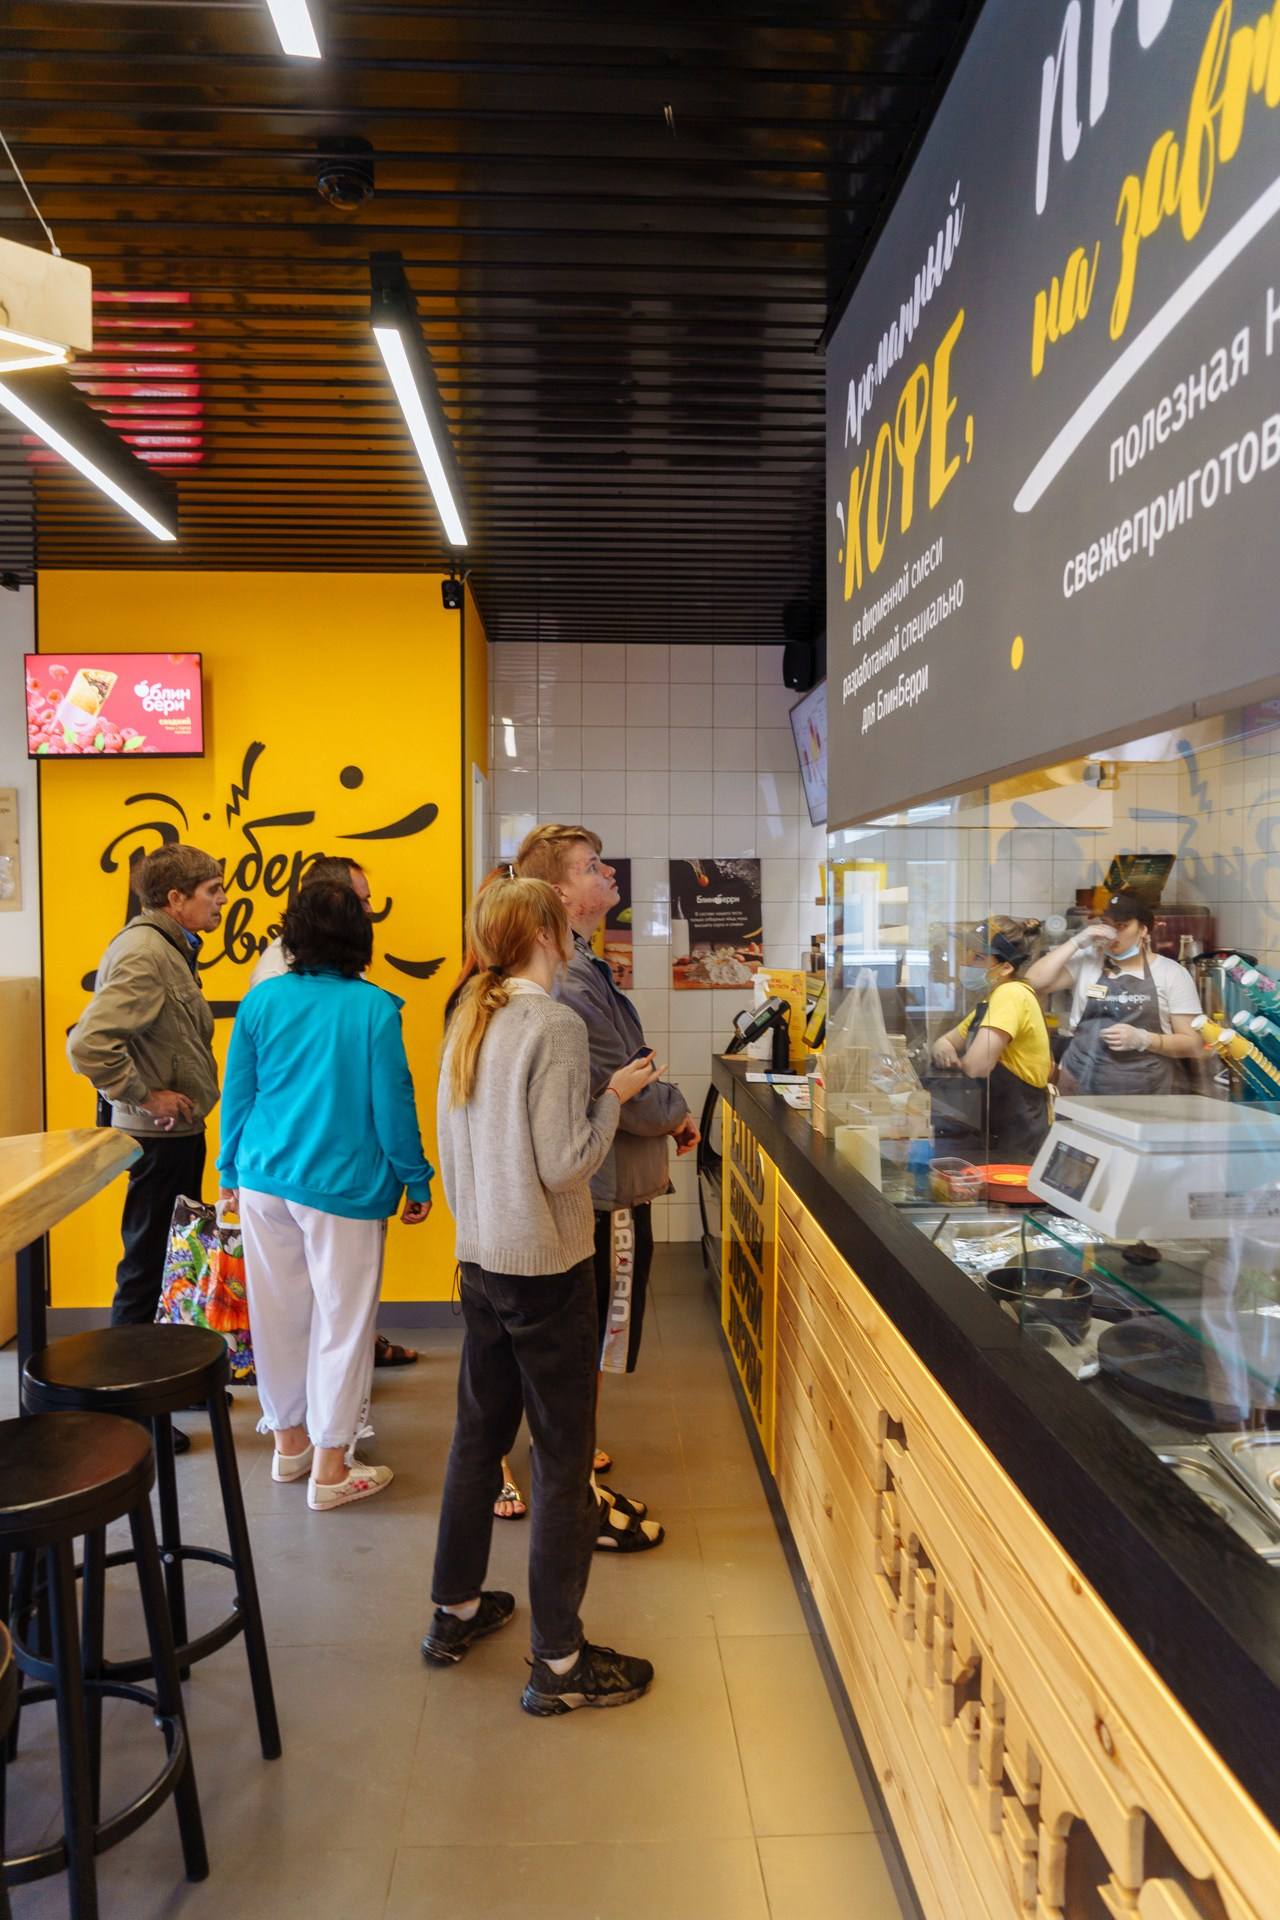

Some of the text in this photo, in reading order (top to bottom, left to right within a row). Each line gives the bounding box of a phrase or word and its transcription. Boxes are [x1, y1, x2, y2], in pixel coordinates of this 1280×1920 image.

[844, 179, 965, 449] Ароматный
[1109, 325, 1249, 483] полезная
[843, 578, 964, 705] разработанной специально
[853, 536, 943, 646] из фирменной смеси
[861, 664, 929, 736] для БлинБерри
[611, 1207, 634, 1323] ORDAN
